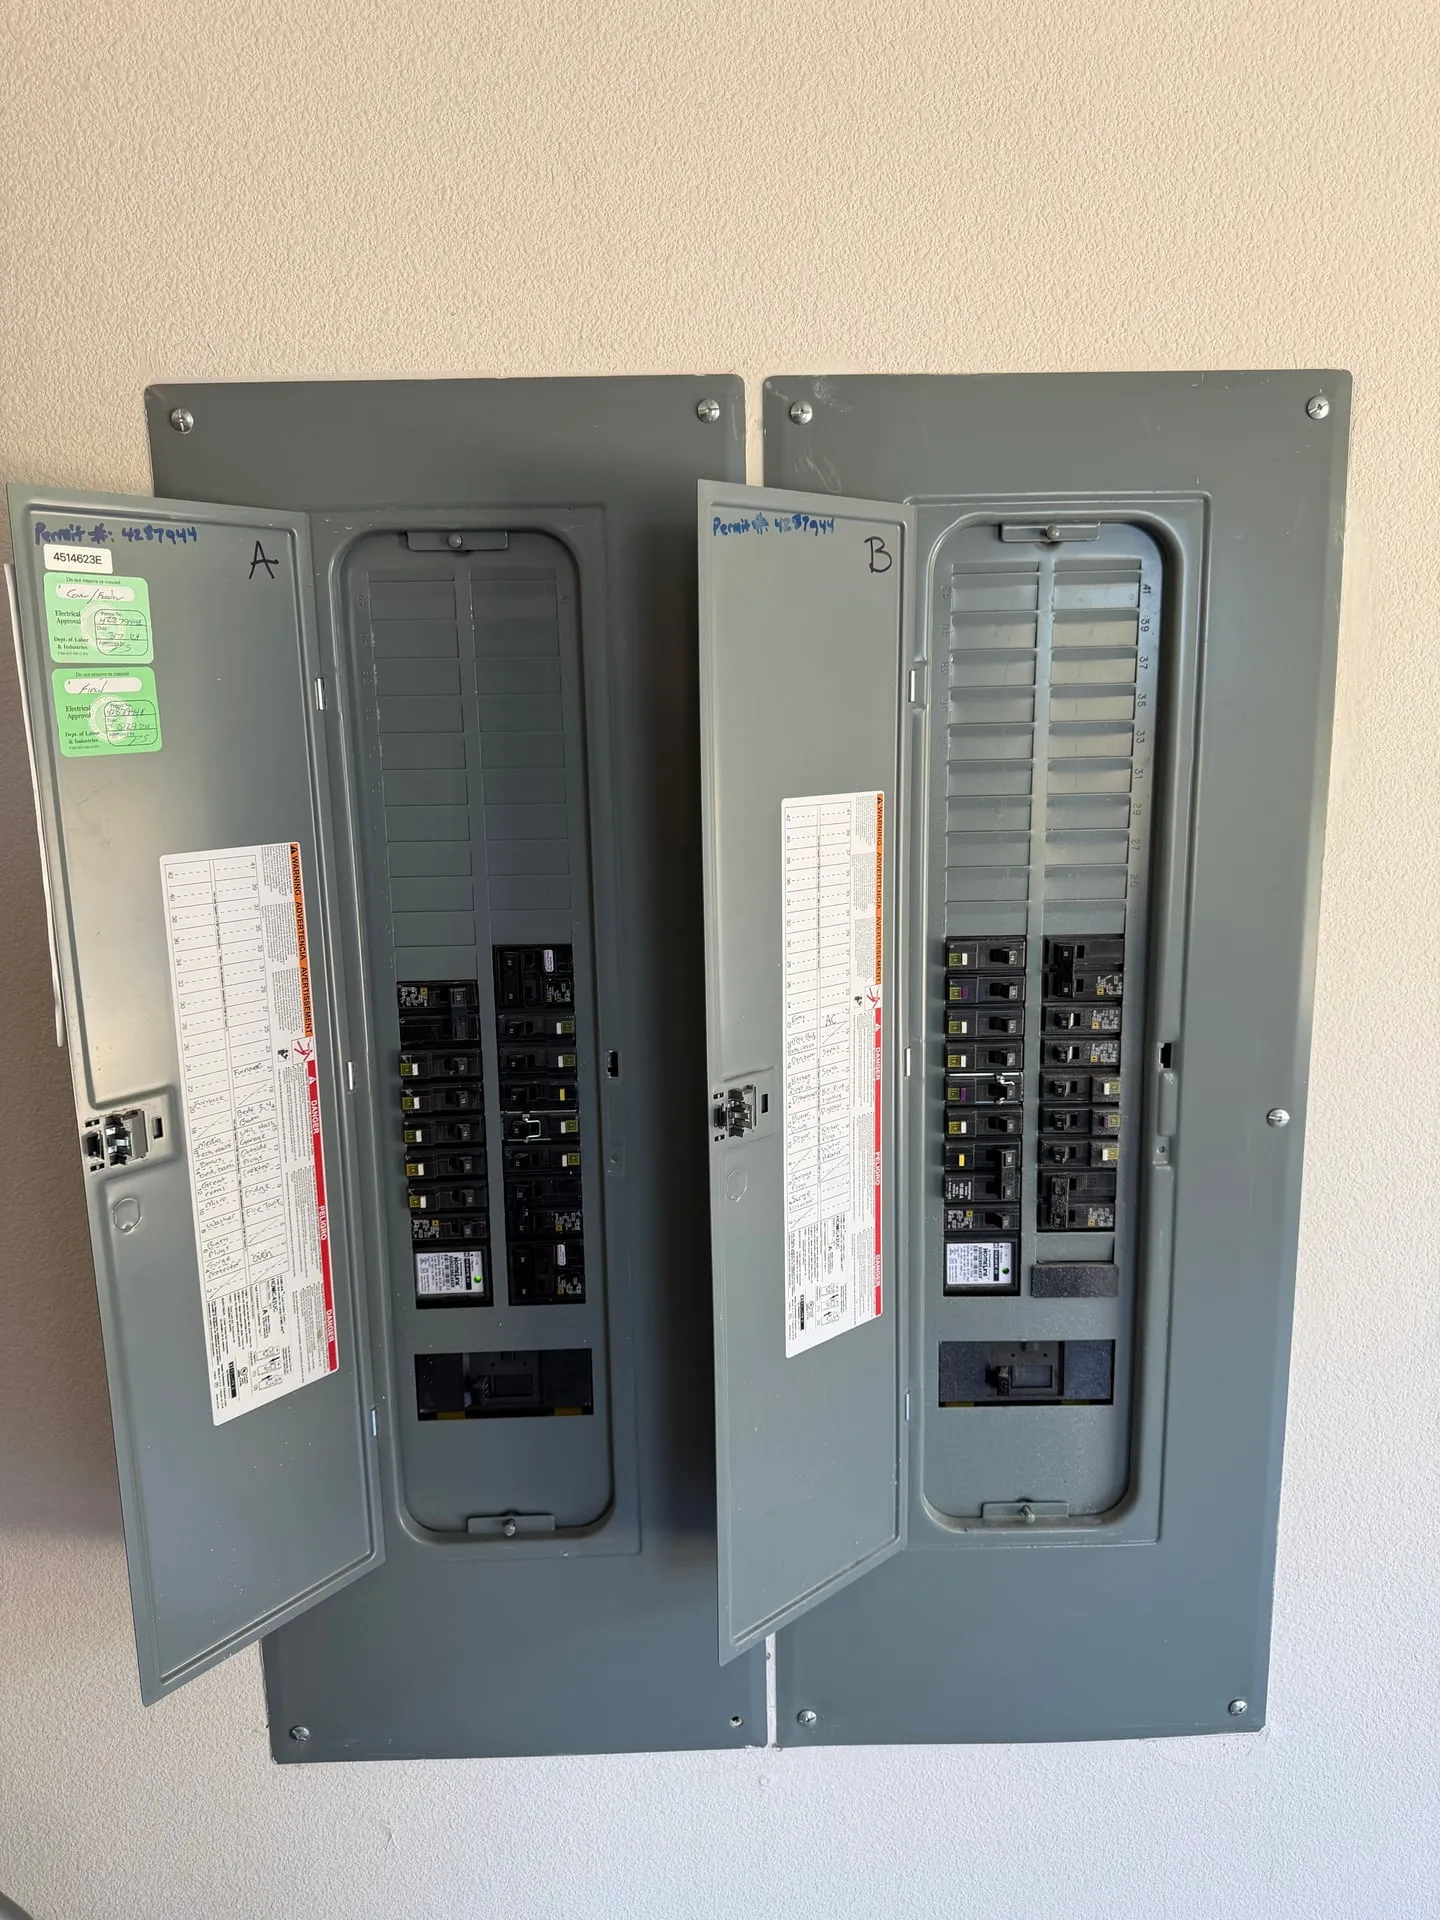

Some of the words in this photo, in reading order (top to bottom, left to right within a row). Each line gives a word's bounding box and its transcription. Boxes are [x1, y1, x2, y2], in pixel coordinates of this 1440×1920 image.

[713, 516, 750, 536] Permit
[35, 522, 85, 545] Permit
[121, 524, 198, 544] 4287944
[53, 552, 103, 565] 4514623E
[249, 540, 278, 579] A
[864, 536, 892, 573] B
[1142, 584, 1152, 594] 41
[1140, 619, 1150, 633] 39
[1139, 657, 1149, 670] 37
[1137, 694, 1146, 707] 35
[1136, 730, 1145, 744] 33
[1134, 768, 1144, 780] 31
[1133, 803, 1142, 815] 29
[1131, 840, 1140, 851] 27
[291, 855, 301, 896] WARNING
[295, 900, 306, 962] ADVERTENCIA
[301, 966, 313, 1034] AVERTISSEMENT
[826, 1013, 837, 1027] AC
[310, 1100, 320, 1135] DANGER
[245, 1184, 270, 1197] Fridge
[319, 1205, 327, 1241] PELIGRO
[327, 1309, 335, 1342] DANGER
